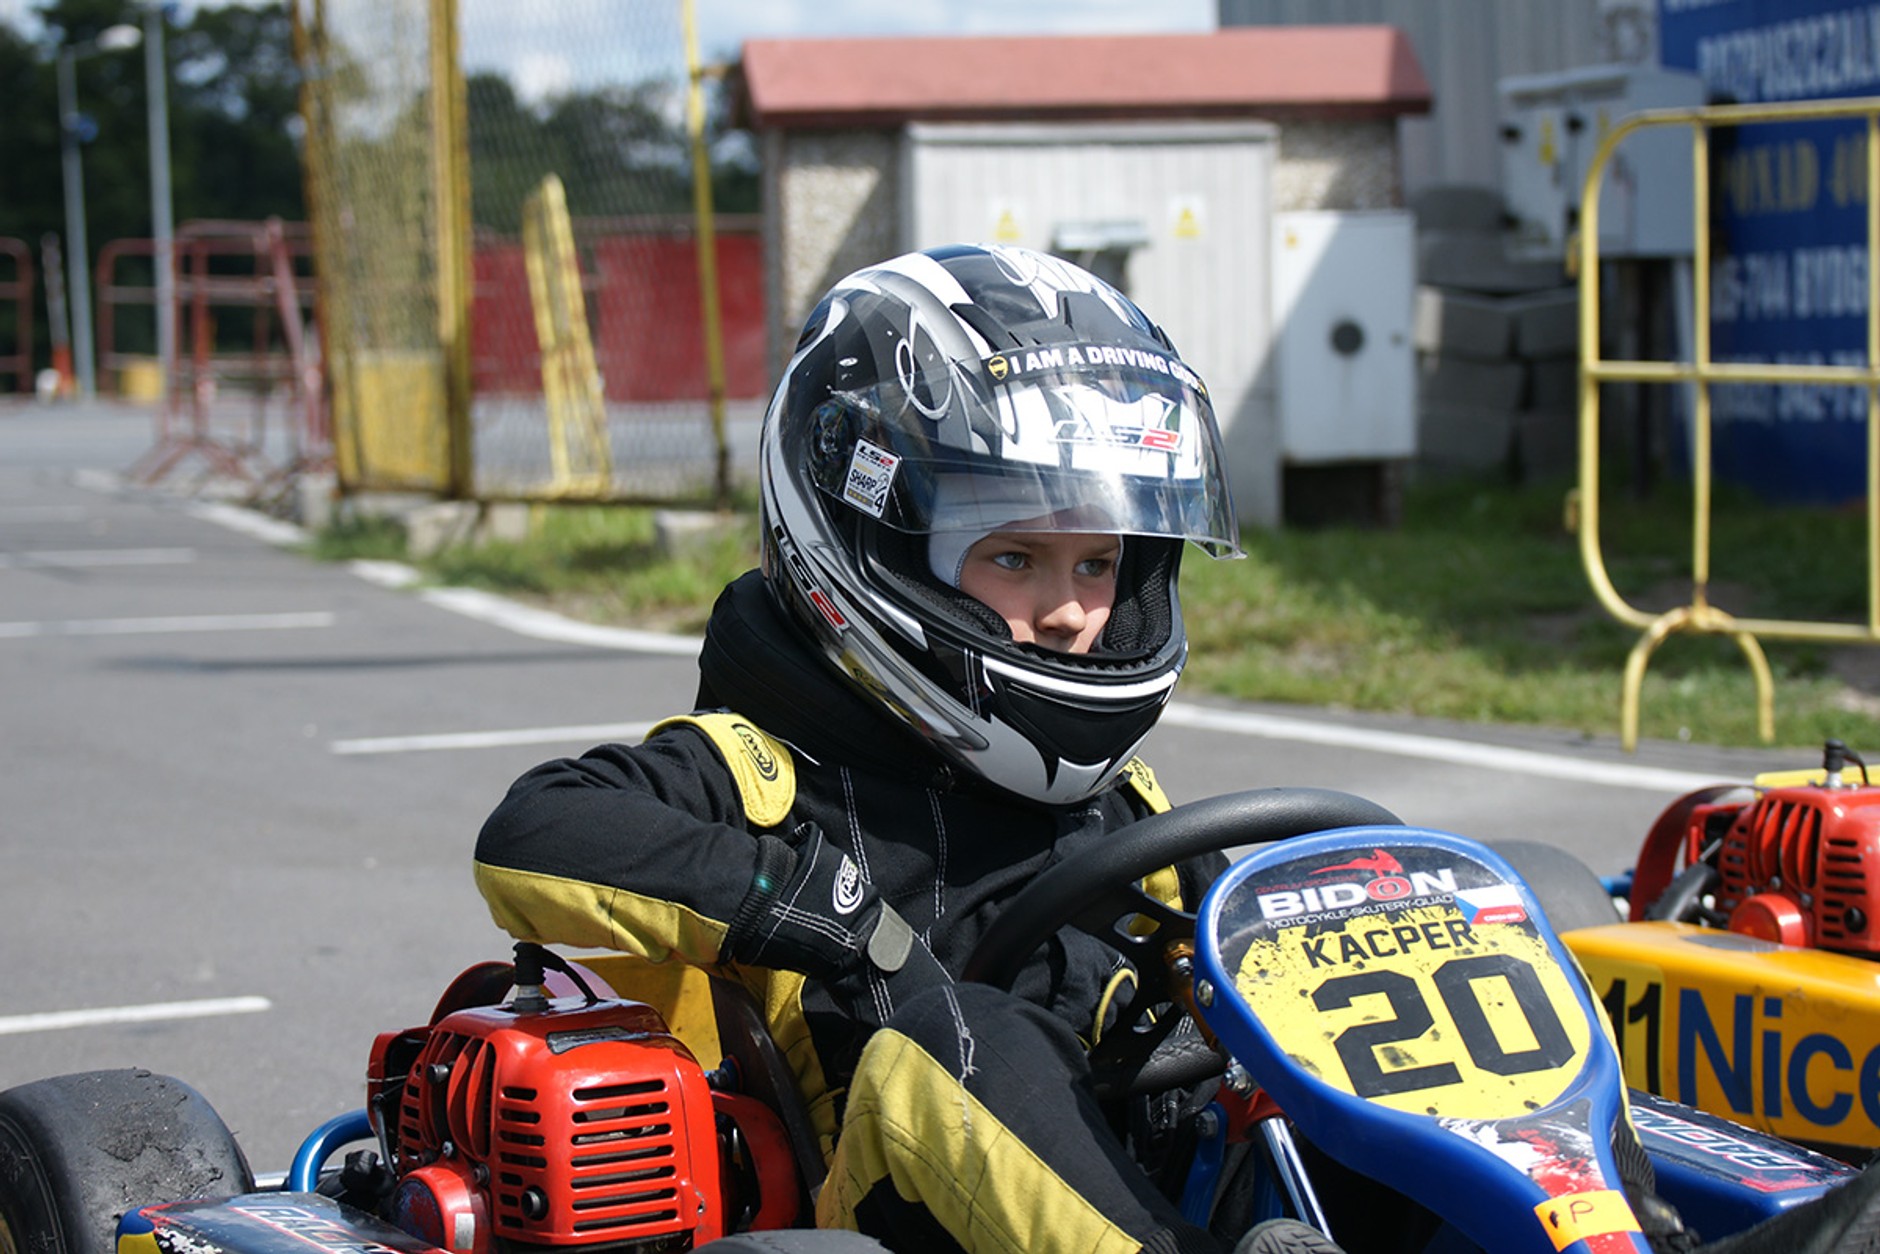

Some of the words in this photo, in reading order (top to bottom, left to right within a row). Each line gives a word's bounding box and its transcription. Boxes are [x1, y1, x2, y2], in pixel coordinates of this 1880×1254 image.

[1011, 356, 1021, 374] I
[1026, 350, 1063, 371] AM
[1068, 347, 1085, 366] A
[1087, 346, 1169, 375] DRIVING
[858, 445, 894, 466] LS2
[849, 468, 877, 490] SHARP
[874, 493, 885, 513] 4
[1257, 867, 1458, 919] BIDON
[1301, 918, 1480, 969] KACPER
[1310, 953, 1577, 1099] 20
[1587, 972, 1662, 1097] 11
[1569, 1199, 1594, 1224] P
